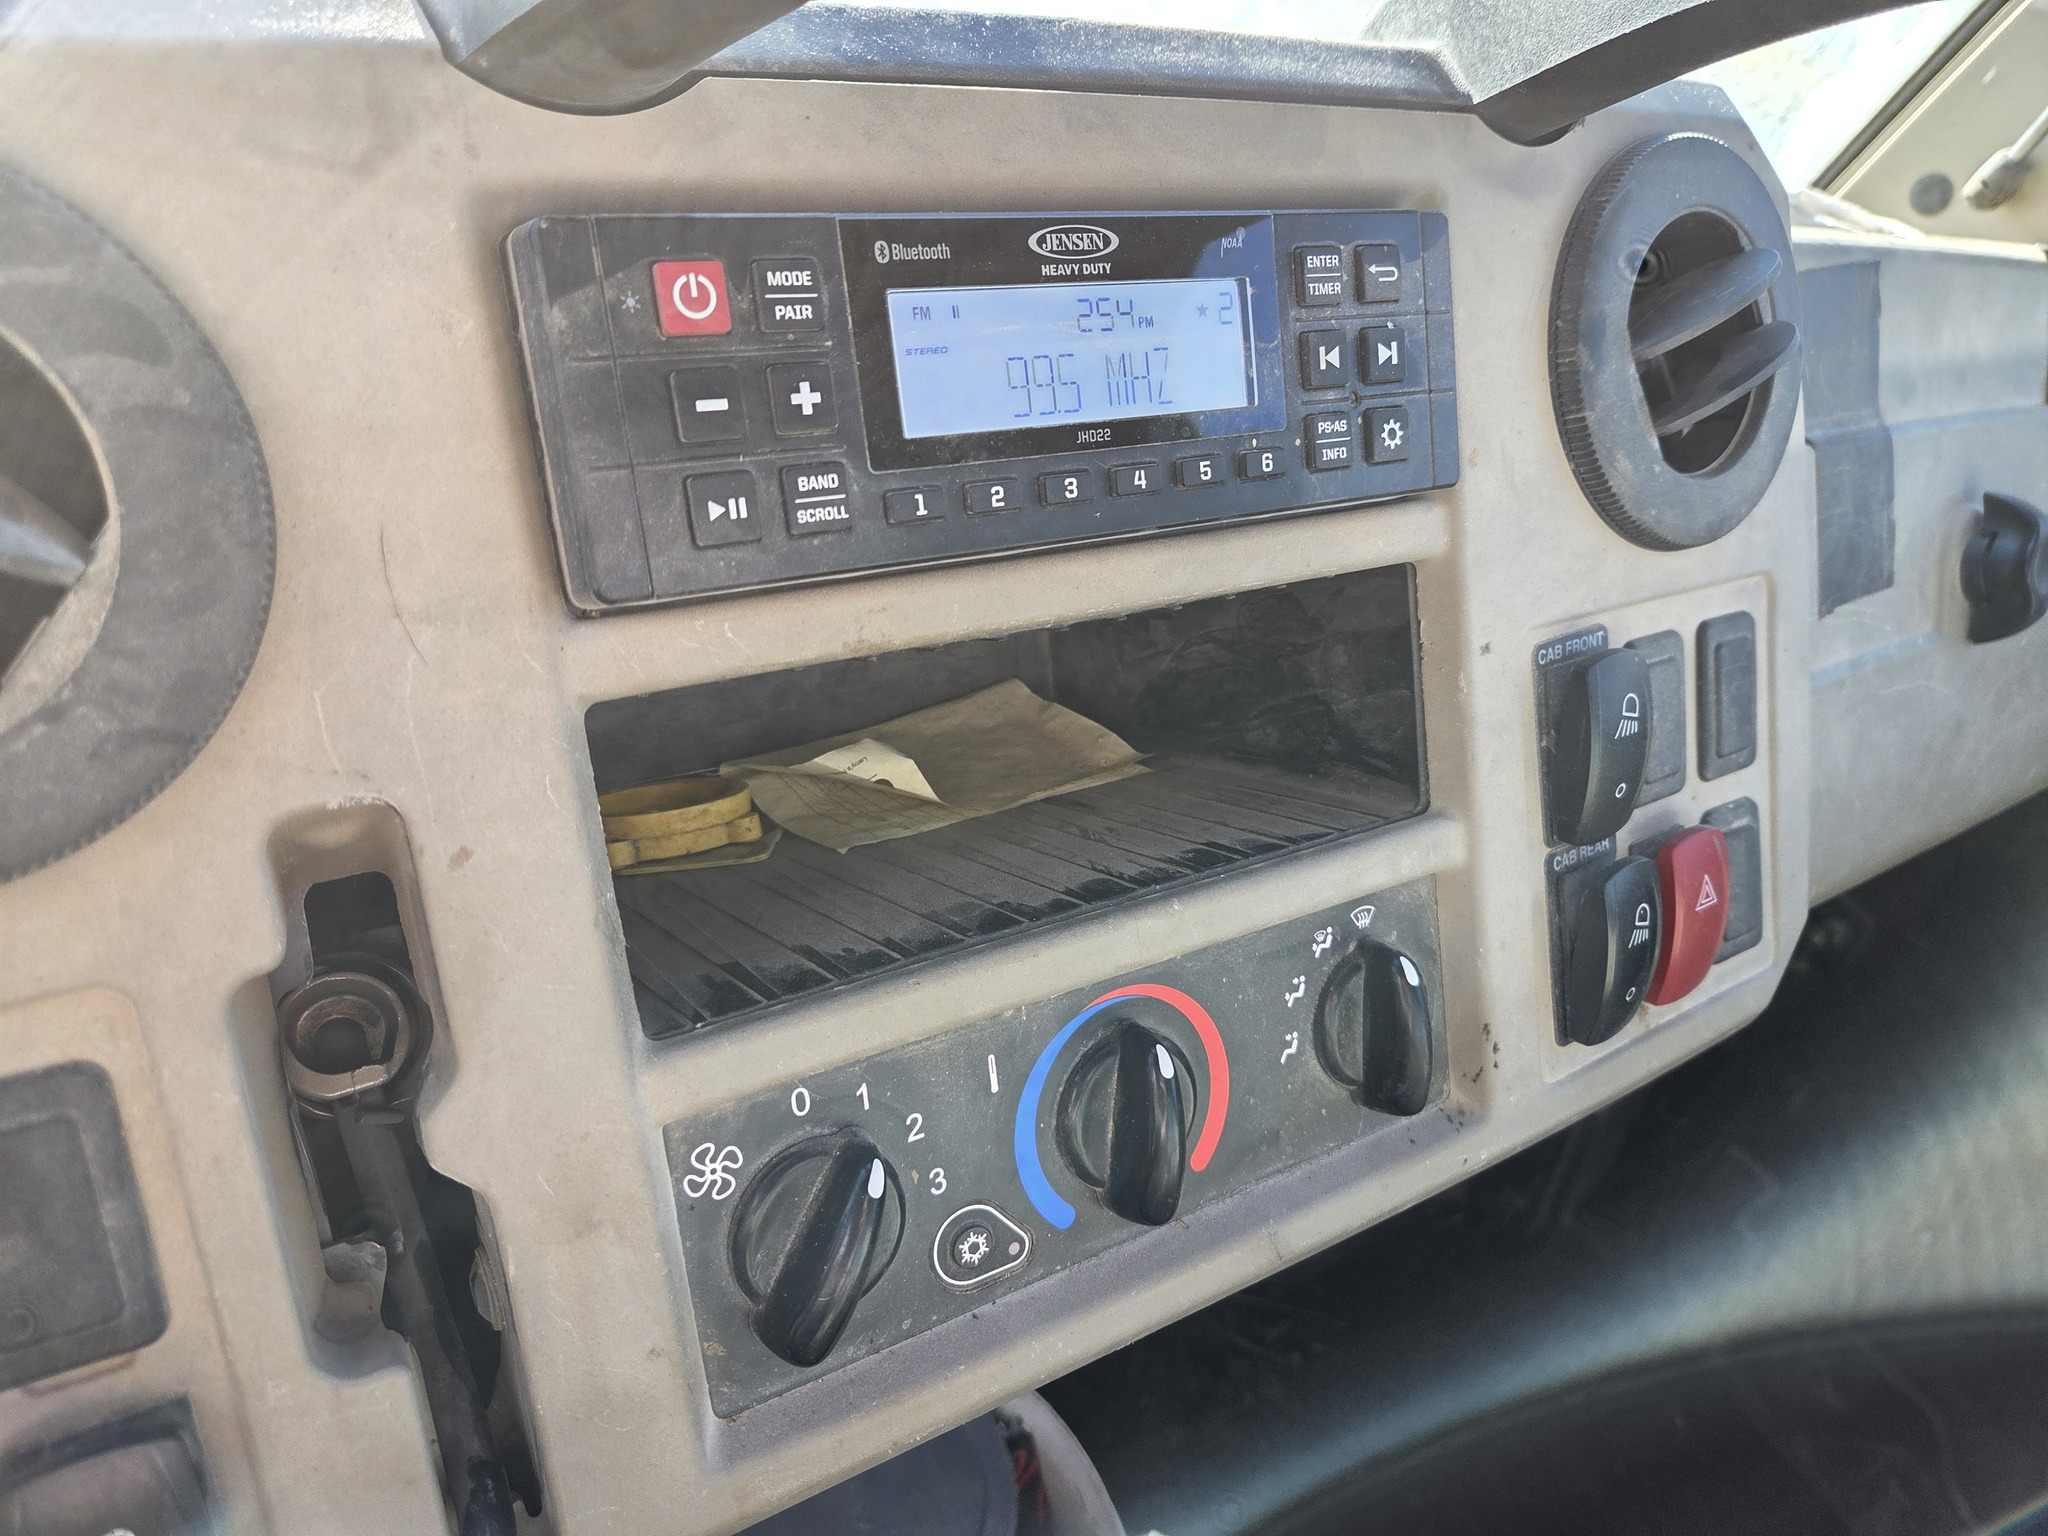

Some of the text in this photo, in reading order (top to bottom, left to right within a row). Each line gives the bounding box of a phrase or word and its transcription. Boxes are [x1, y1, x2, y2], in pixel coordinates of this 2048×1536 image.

[1042, 233, 1104, 251] JENSEN
[892, 243, 951, 261] Bluetooth
[1306, 255, 1339, 268] ENTER
[766, 270, 813, 287] MODE
[1041, 262, 1111, 276] HEAVY DUTY
[1308, 282, 1341, 296] TIMER
[774, 304, 813, 321] PAIR
[912, 306, 932, 321] FM
[1218, 291, 1233, 325] 2
[1138, 315, 1154, 328] PM
[905, 346, 949, 356] STEREO
[1076, 428, 1112, 444] JHD22
[1261, 452, 1274, 473] 6
[1321, 447, 1347, 461] INFO
[1133, 469, 1147, 490] 4
[1199, 460, 1212, 481] 5
[797, 473, 839, 492] BAND
[1064, 477, 1078, 499] 3
[914, 493, 928, 516] 1
[990, 485, 1005, 508] 2
[796, 505, 850, 524] SCROLL
[1538, 630, 1605, 665] CAB FRONT
[1553, 837, 1610, 871] CAB REAR
[791, 1087, 811, 1117] 0
[856, 1082, 870, 1111] 1
[905, 1113, 925, 1143] 2
[929, 1167, 948, 1195] 3
